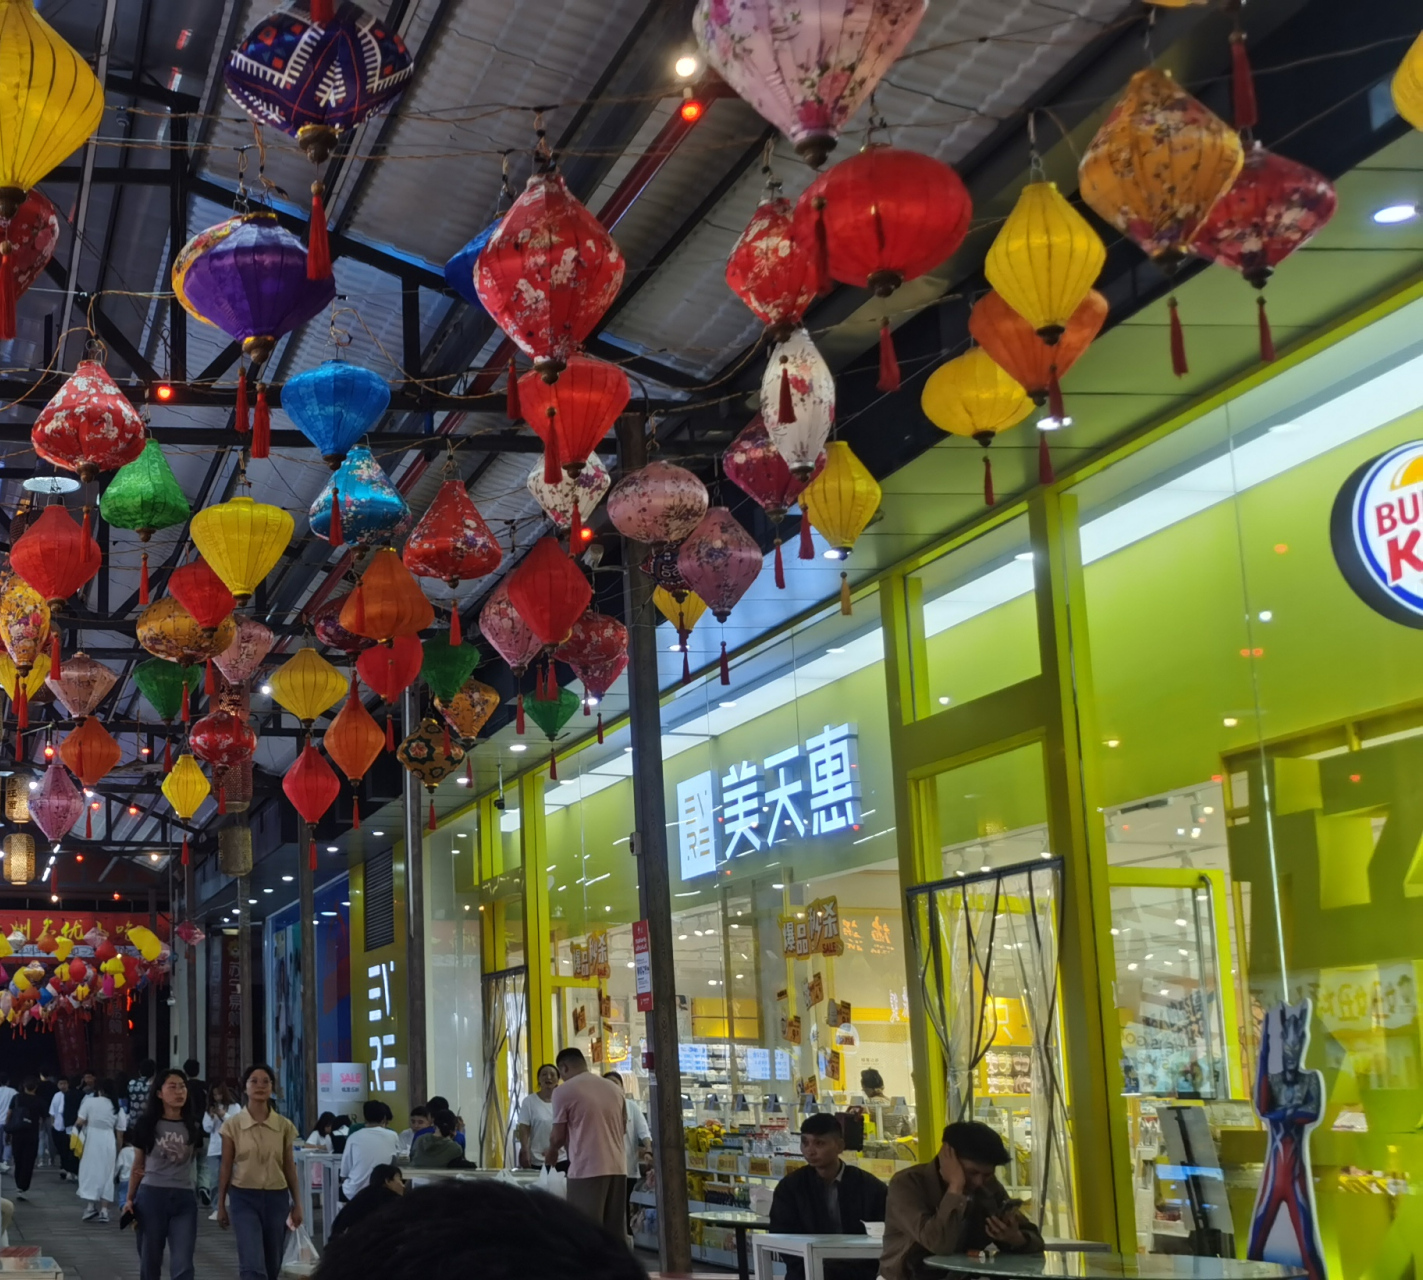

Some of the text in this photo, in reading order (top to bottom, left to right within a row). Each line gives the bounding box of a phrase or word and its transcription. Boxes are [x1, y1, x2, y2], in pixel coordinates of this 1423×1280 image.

[1375, 491, 1423, 537] BU
[721, 722, 859, 860] 美天惠
[822, 943, 837, 954] SALE
